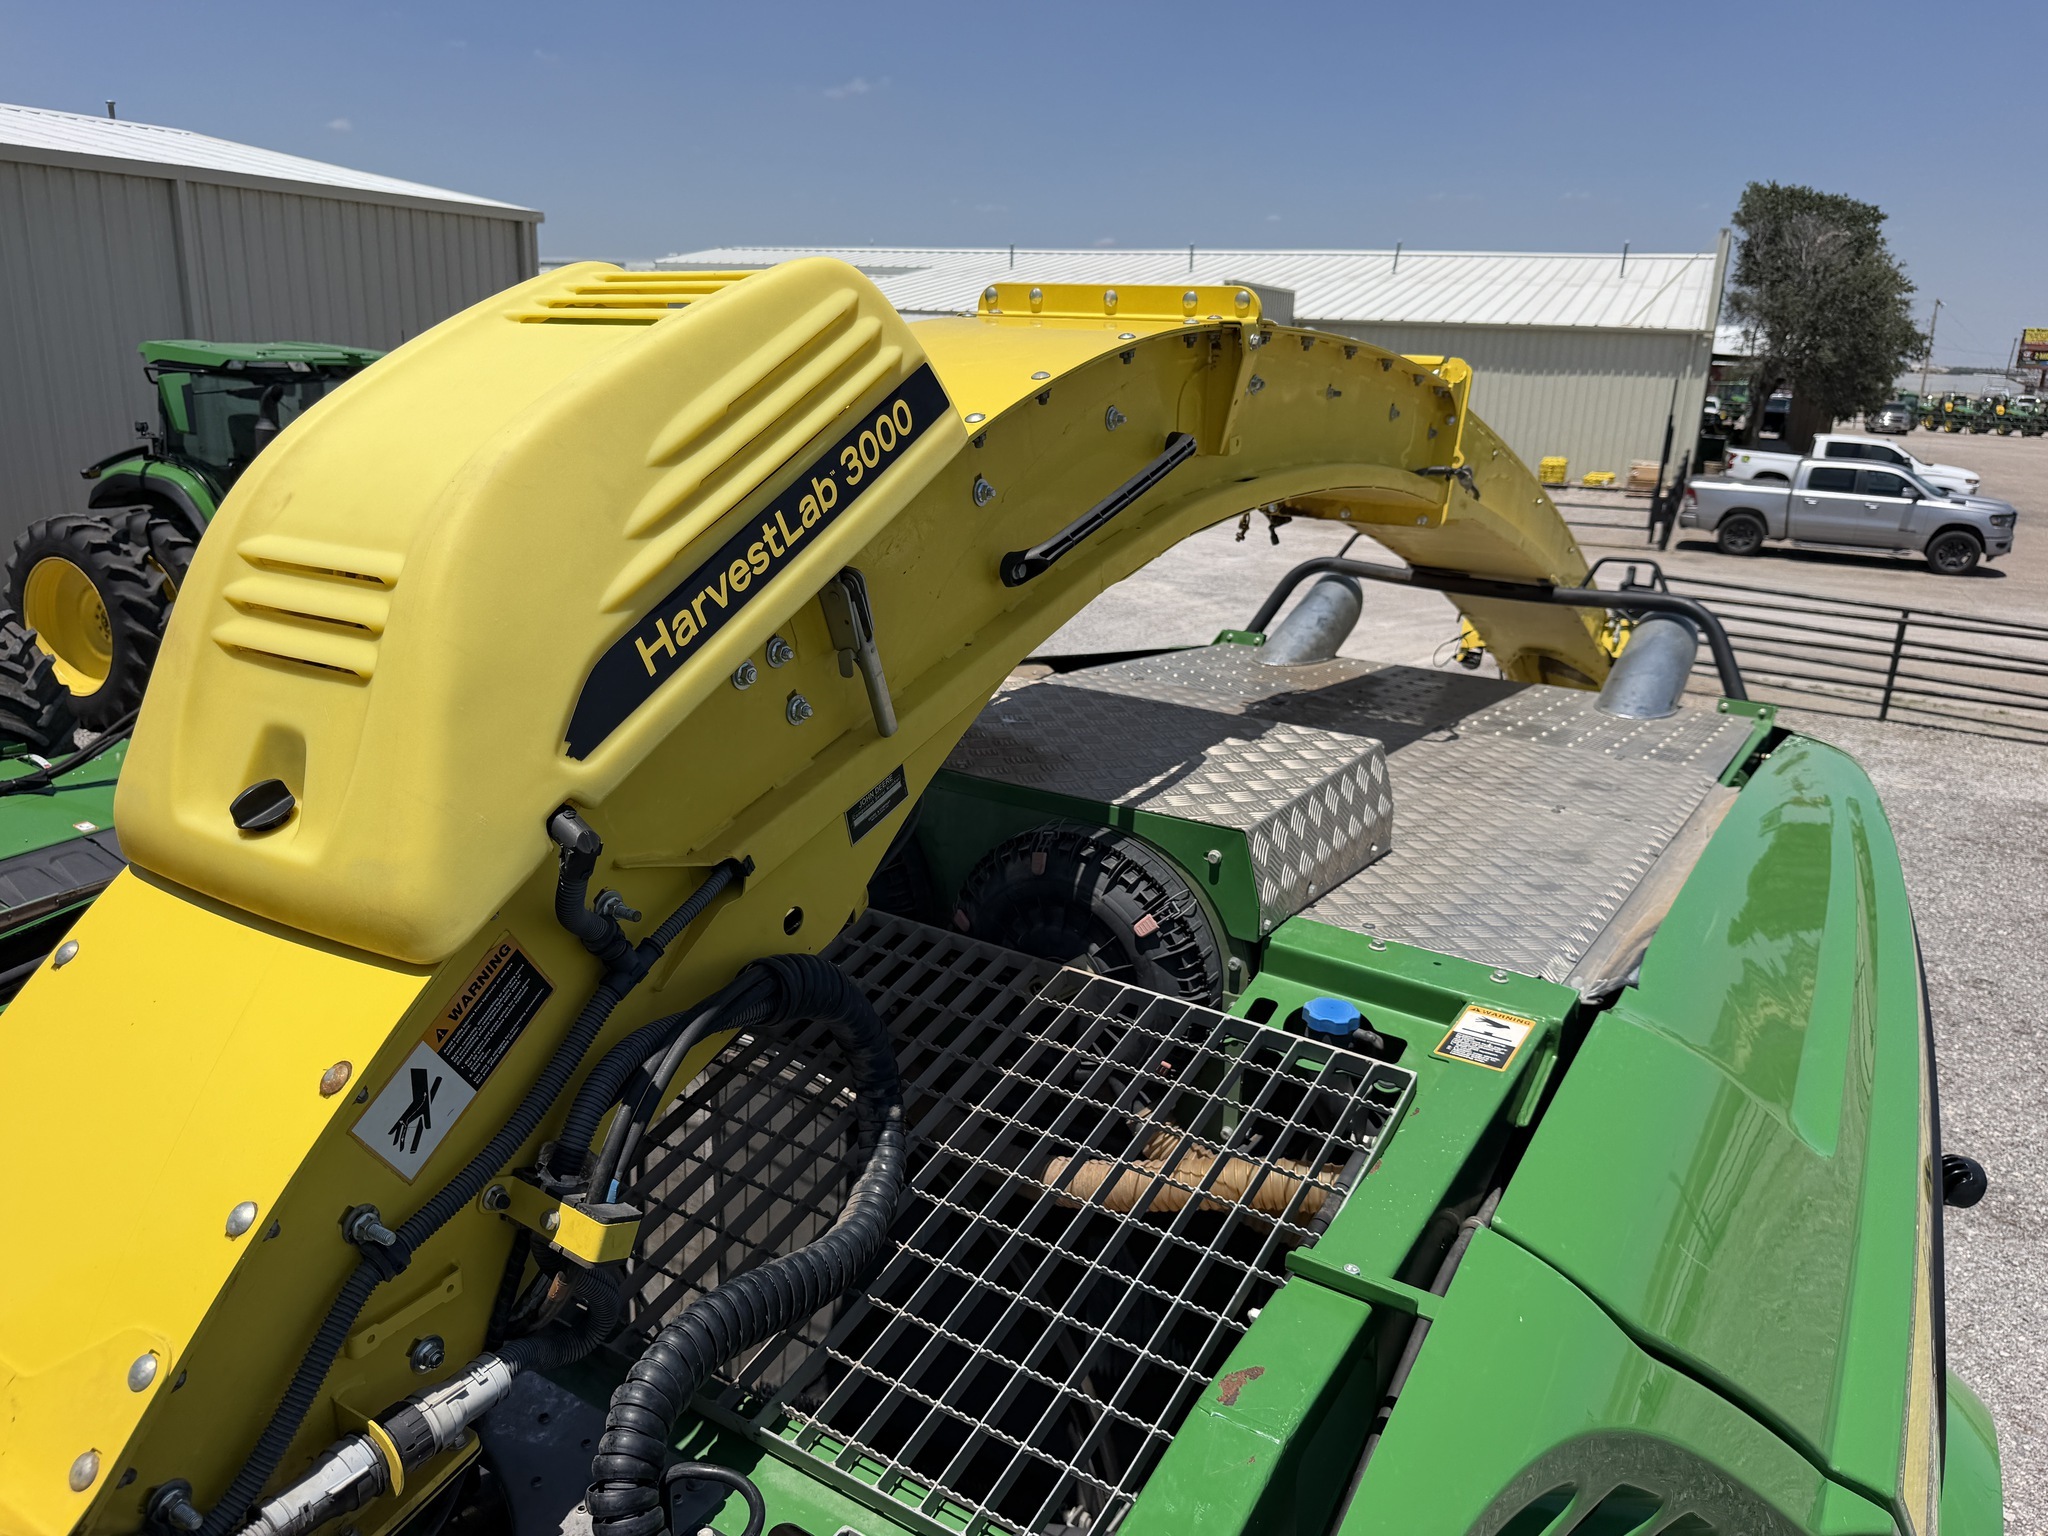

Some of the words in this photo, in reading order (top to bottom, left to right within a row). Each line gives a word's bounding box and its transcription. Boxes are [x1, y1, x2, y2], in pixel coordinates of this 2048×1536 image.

[840, 399, 913, 486] 3000
[859, 790, 875, 809] JOHN
[447, 944, 511, 1021] WARNING
[1482, 1010, 1531, 1026] WARNING
